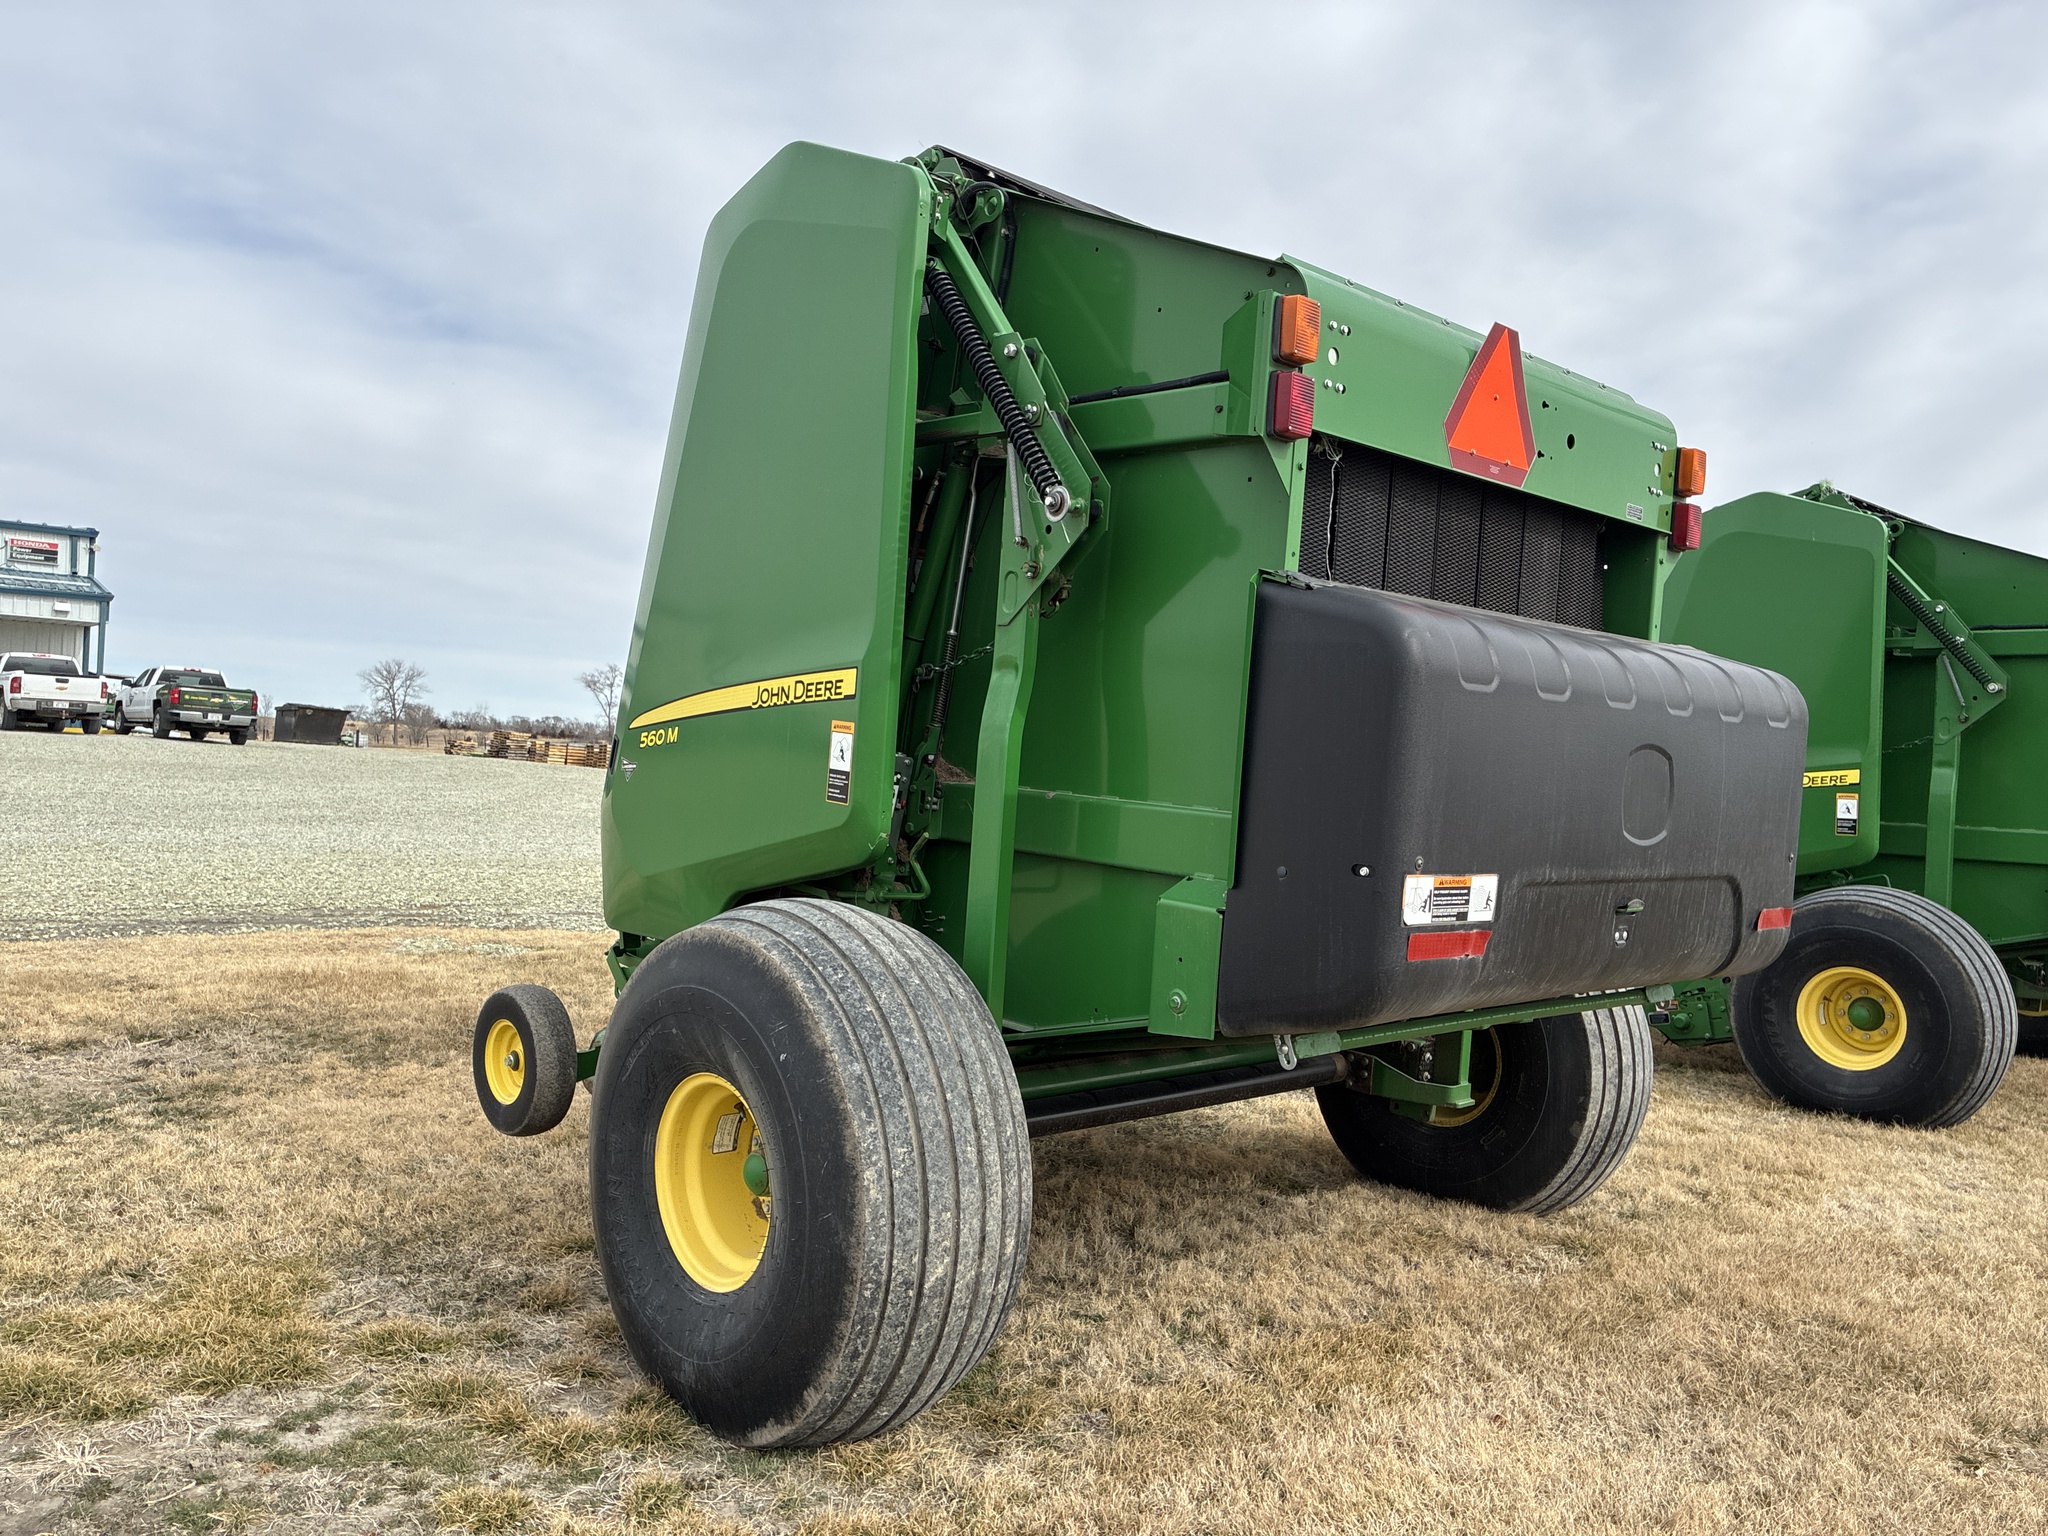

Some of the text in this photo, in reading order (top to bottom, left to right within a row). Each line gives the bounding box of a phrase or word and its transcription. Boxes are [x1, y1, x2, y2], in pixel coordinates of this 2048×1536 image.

[13, 540, 50, 548] HONDA
[13, 552, 45, 561] Equipment
[752, 679, 844, 706] JOHN DEERE
[639, 726, 679, 748] 560 M
[1802, 774, 1849, 786] DEERE
